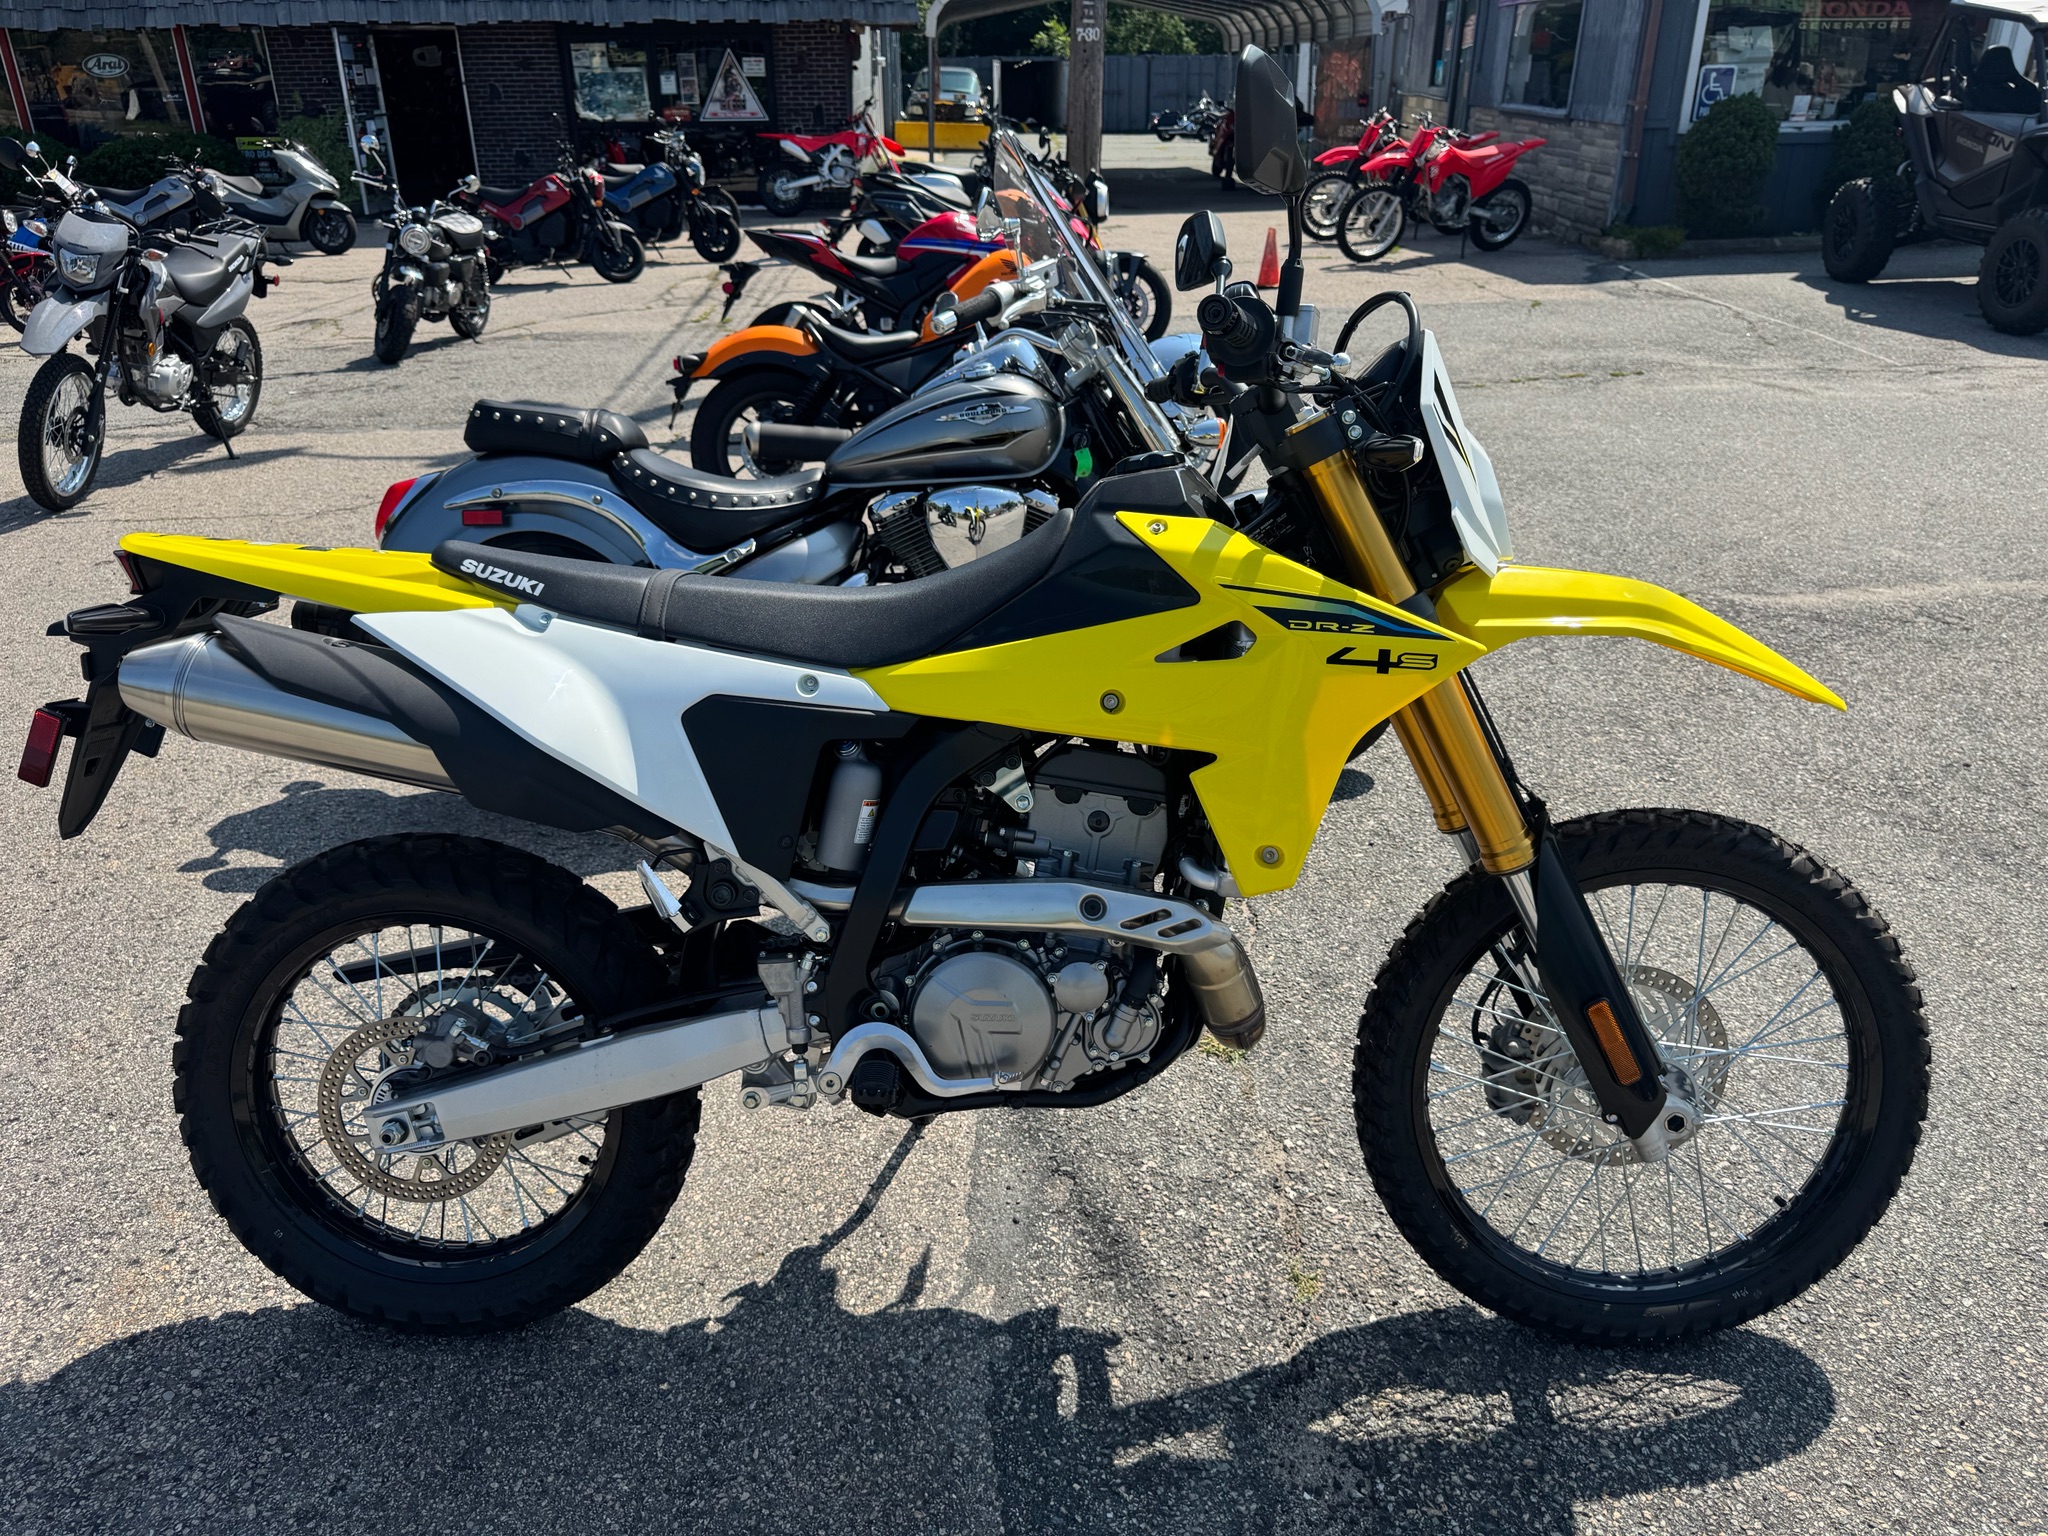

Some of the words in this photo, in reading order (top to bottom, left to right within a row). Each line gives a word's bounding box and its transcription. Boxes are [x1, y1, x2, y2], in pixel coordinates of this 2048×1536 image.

[1802, 0, 1912, 16] HONDA
[1798, 21, 1911, 30] GENERATORS
[959, 407, 1007, 418] BOULEVARD
[460, 559, 545, 597] SUZUKI
[1288, 619, 1375, 633] DR-Z
[970, 1013, 1016, 1022] SUZUKI
